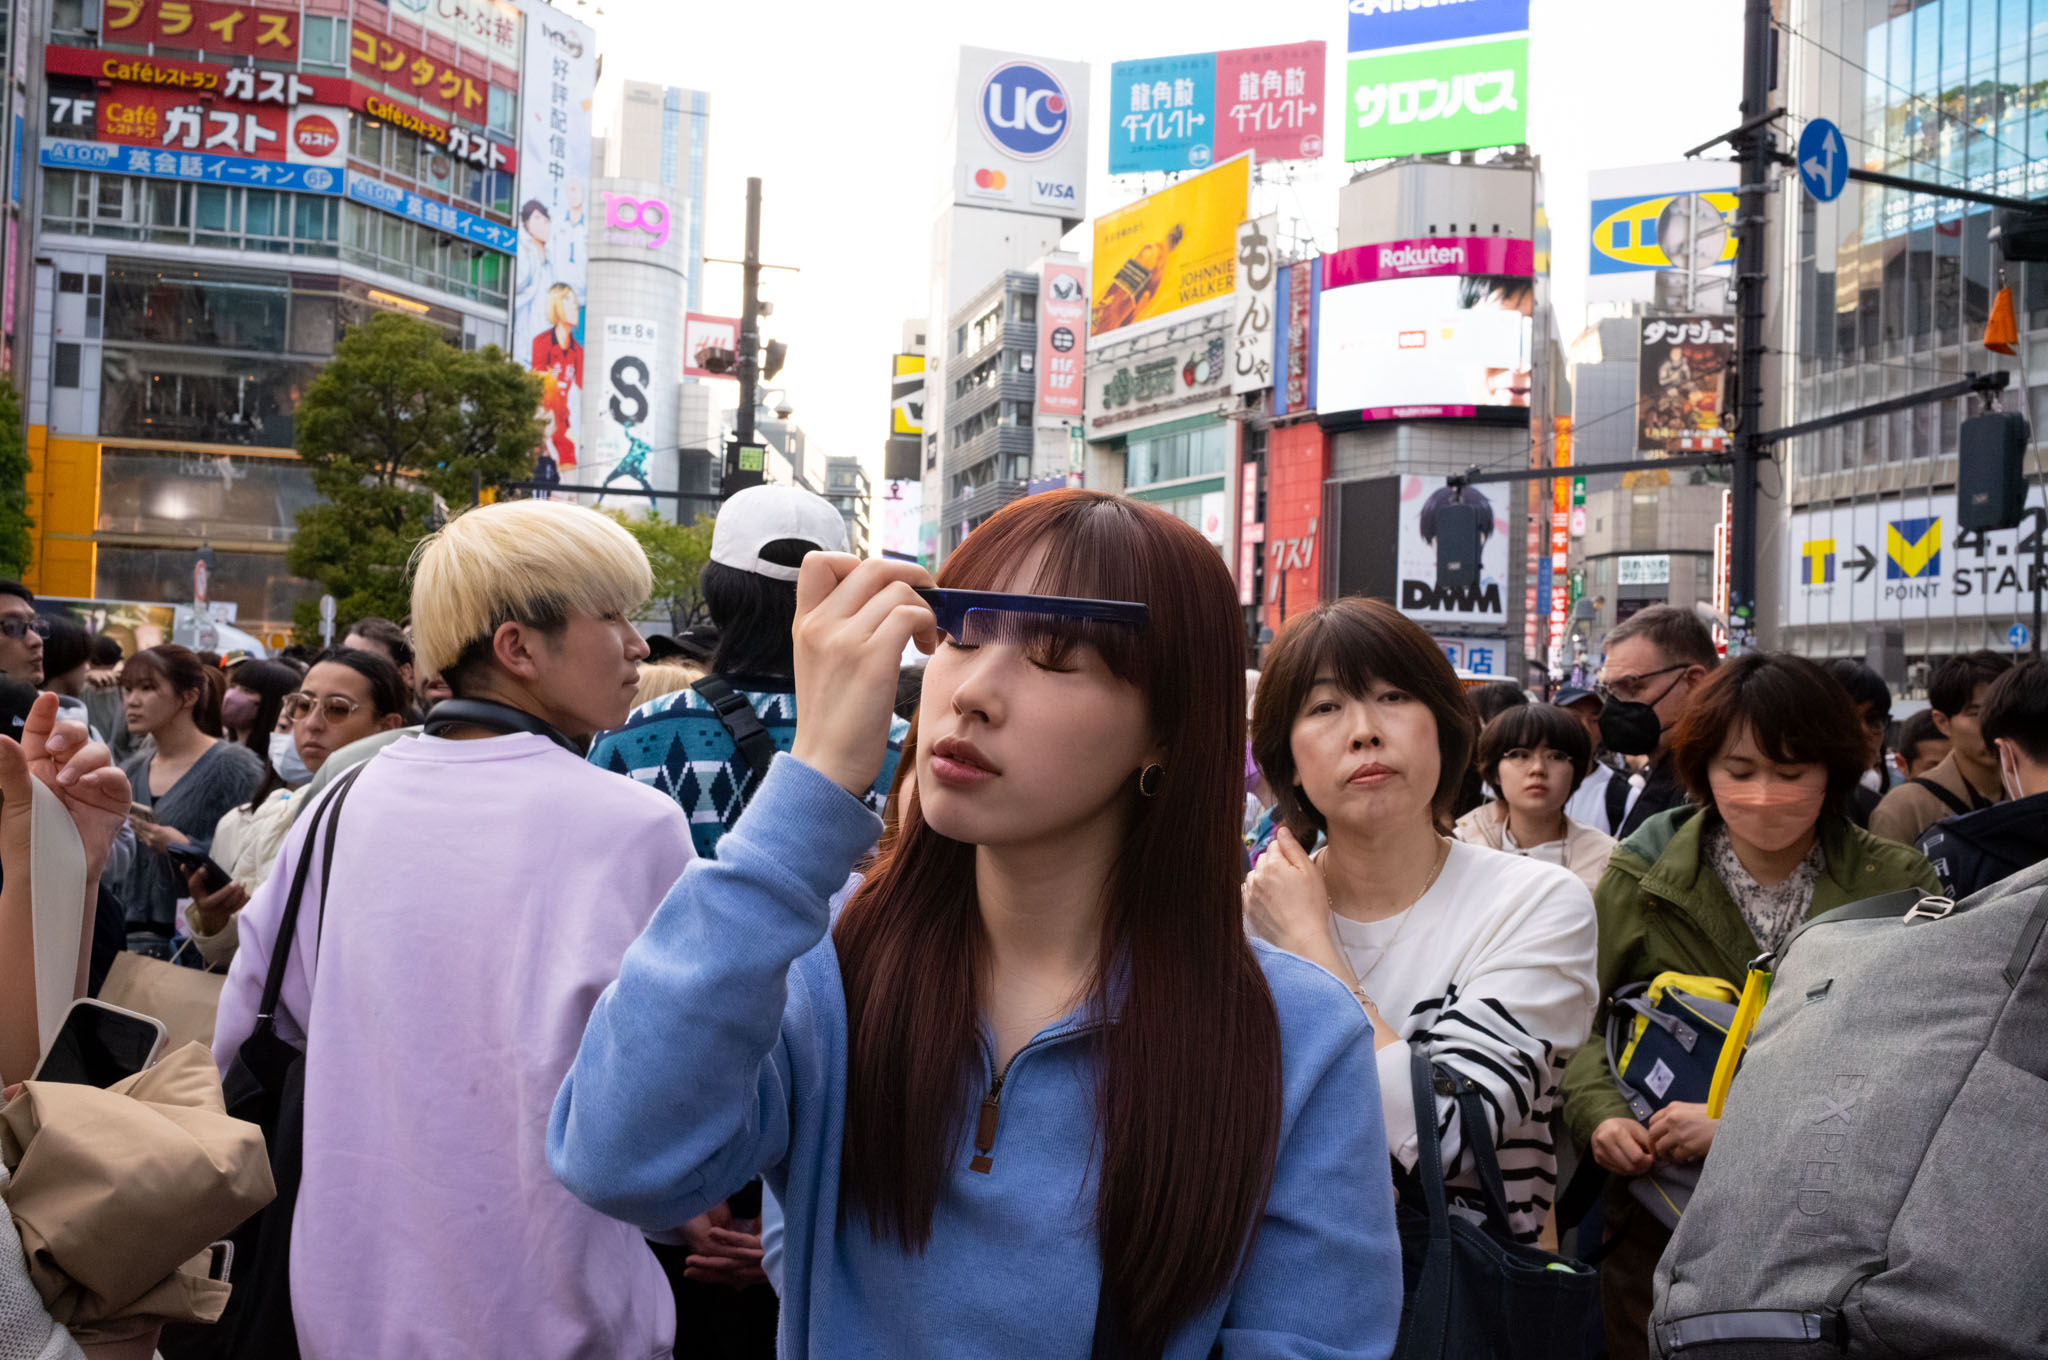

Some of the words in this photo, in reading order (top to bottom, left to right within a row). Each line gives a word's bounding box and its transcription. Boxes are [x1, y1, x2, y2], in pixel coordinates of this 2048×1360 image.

[107, 0, 292, 48] プライス
[352, 29, 482, 109] コンタクト
[224, 67, 314, 104] ガスト
[1354, 69, 1518, 128] サロンパス
[49, 97, 96, 125] 7F
[106, 103, 158, 125] Café
[162, 105, 278, 153] ガスト
[299, 132, 335, 147] ガスト
[51, 143, 108, 164] AEON
[448, 127, 507, 169] ガスト
[1037, 181, 1075, 200] VISA
[600, 192, 670, 248] 109
[1380, 245, 1464, 268] Rakuten
[1179, 275, 1234, 303] WALKER
[1181, 258, 1234, 288] JOHNNIE
[1239, 221, 1272, 383] もんじゃ
[1402, 579, 1502, 613] DMM
[1885, 583, 1941, 600] POINT
